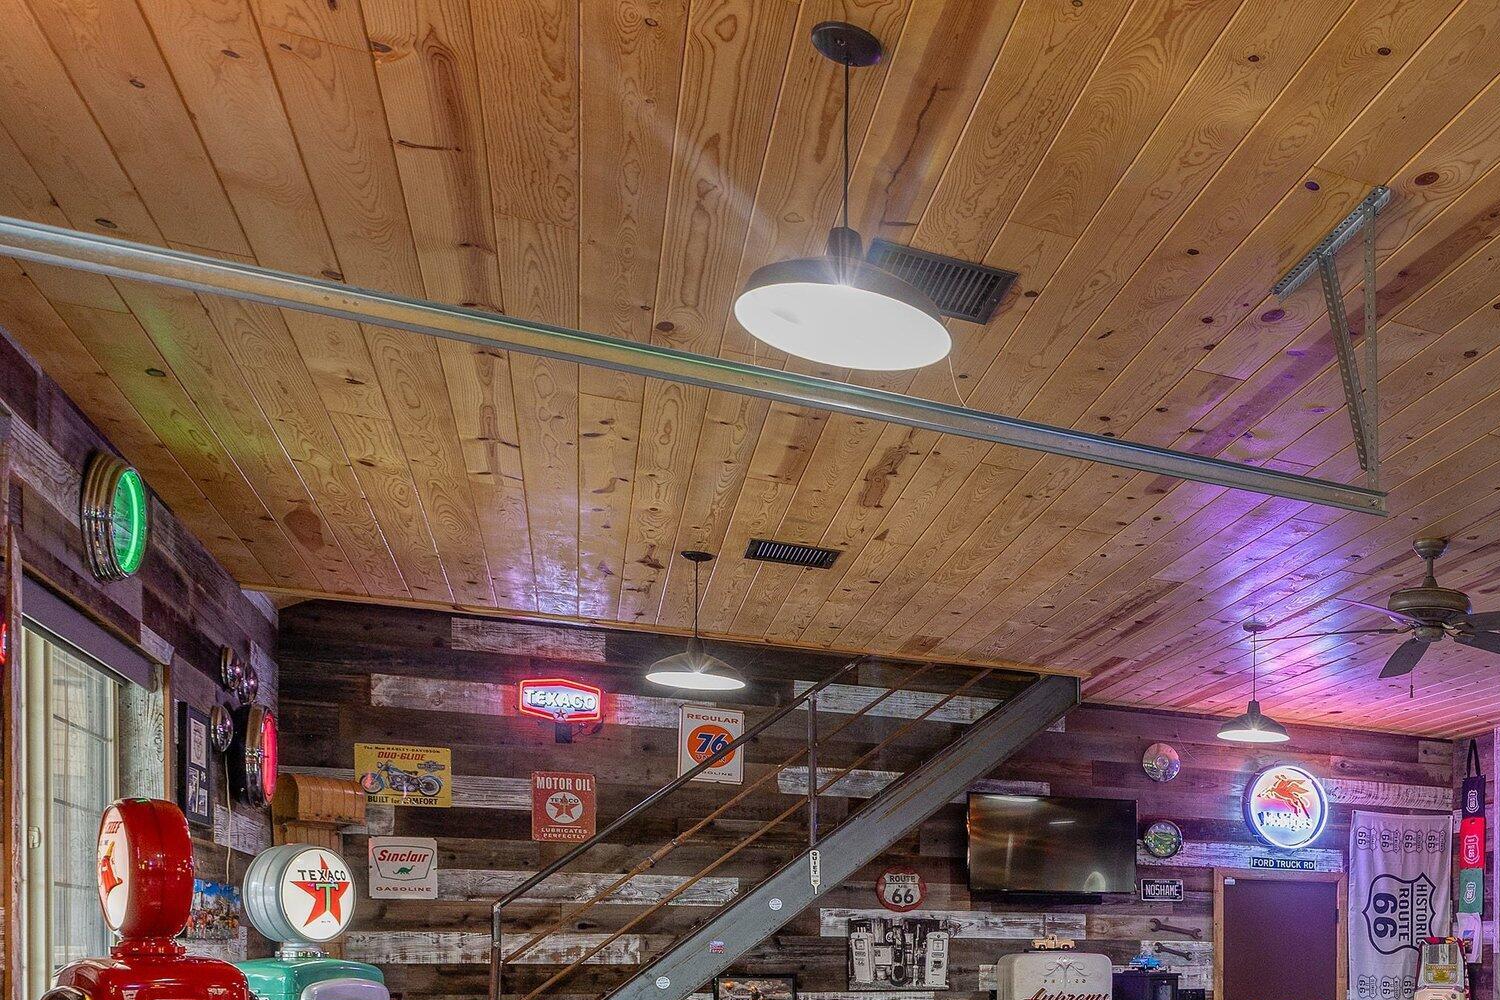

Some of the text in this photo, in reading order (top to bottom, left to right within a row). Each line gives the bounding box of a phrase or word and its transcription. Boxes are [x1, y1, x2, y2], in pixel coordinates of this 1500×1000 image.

[525, 689, 597, 712] TEXACO
[687, 713, 739, 725] REGULAR
[695, 733, 729, 755] 76
[536, 776, 592, 791] MOTOR OIL
[368, 795, 389, 803] BUILT
[378, 850, 429, 862] Sinclair
[1253, 859, 1314, 870] FORD TRUCK RD
[298, 869, 346, 881] TEXACO
[891, 888, 914, 904] 66
[1372, 892, 1398, 938] 66
[1399, 888, 1410, 942] ROUTE
[1416, 884, 1428, 945] HISTORIC
